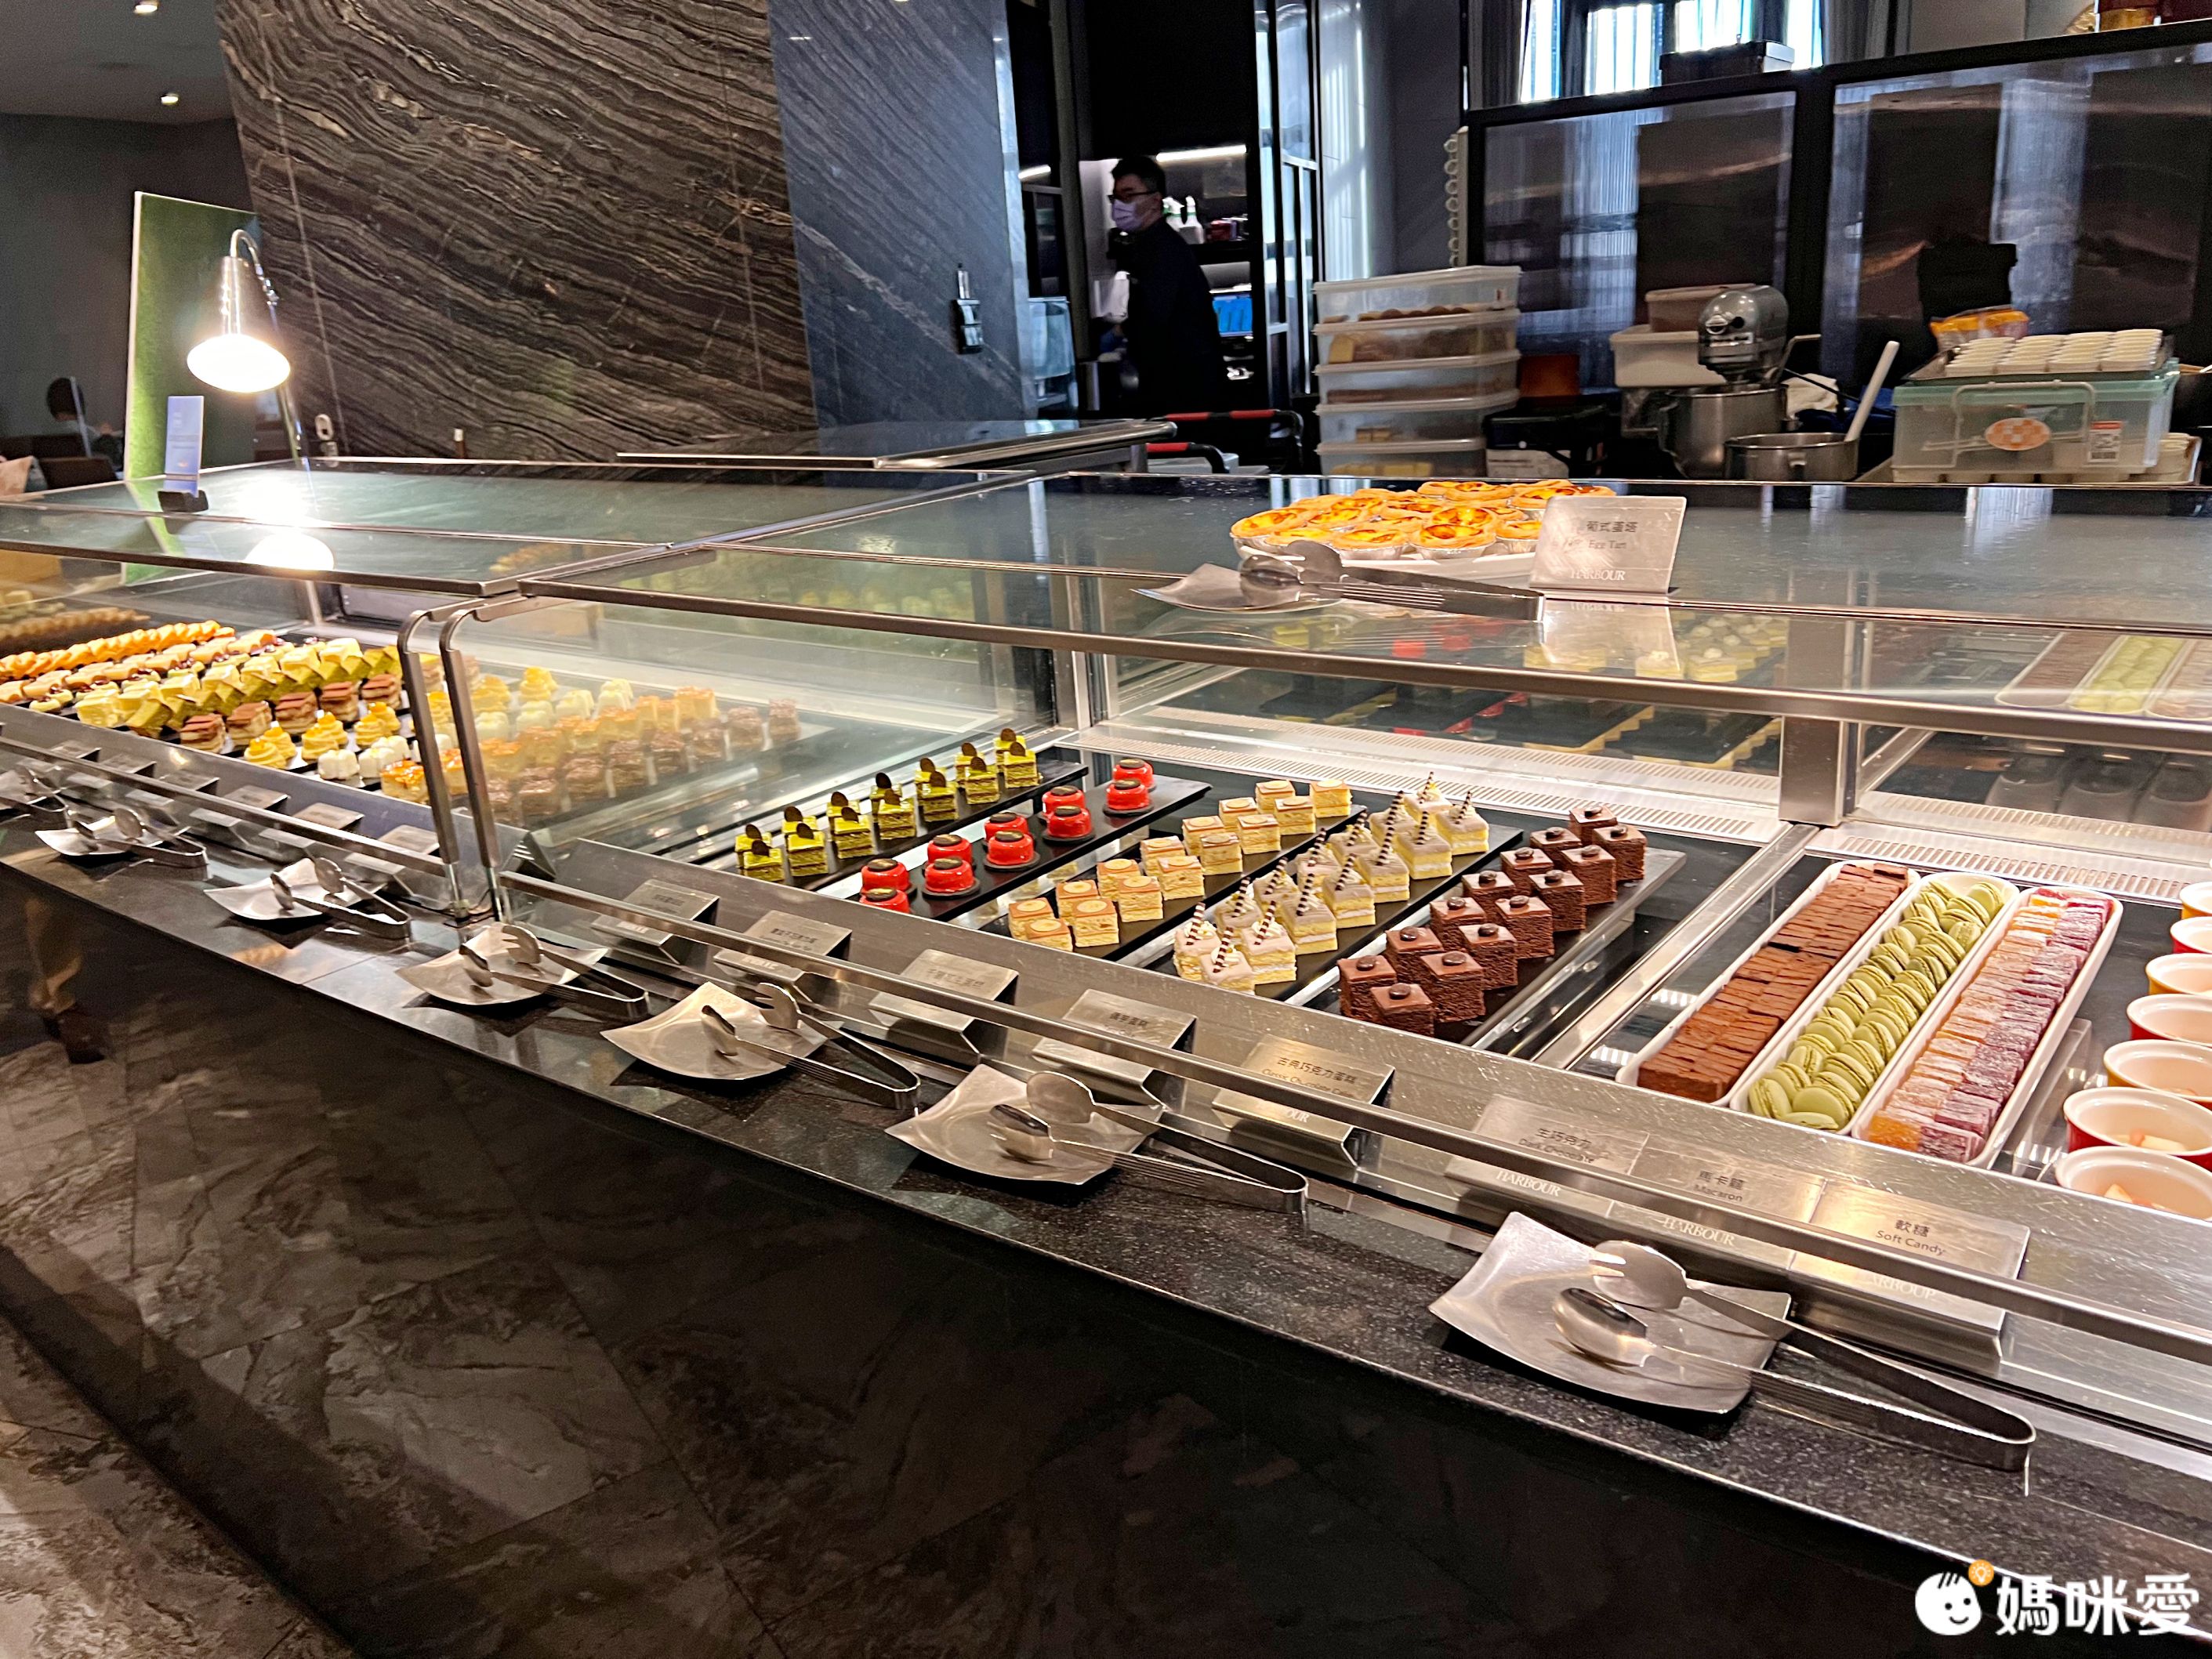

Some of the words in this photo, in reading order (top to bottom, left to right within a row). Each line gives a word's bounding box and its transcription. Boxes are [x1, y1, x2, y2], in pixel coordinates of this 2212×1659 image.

[1570, 569, 1626, 581] HARBOUR
[1277, 1056, 1358, 1085] 古典巧克力蛋糕
[1536, 1128, 1592, 1149] 生巧克力
[1496, 1170, 1562, 1197] HARBOUR
[1692, 1183, 1743, 1202] Macaron
[1662, 1217, 1735, 1247] HARBOUR
[1895, 1219, 1930, 1237] 軟糖
[1876, 1230, 1902, 1244] Soft
[1905, 1237, 1946, 1256] Candy
